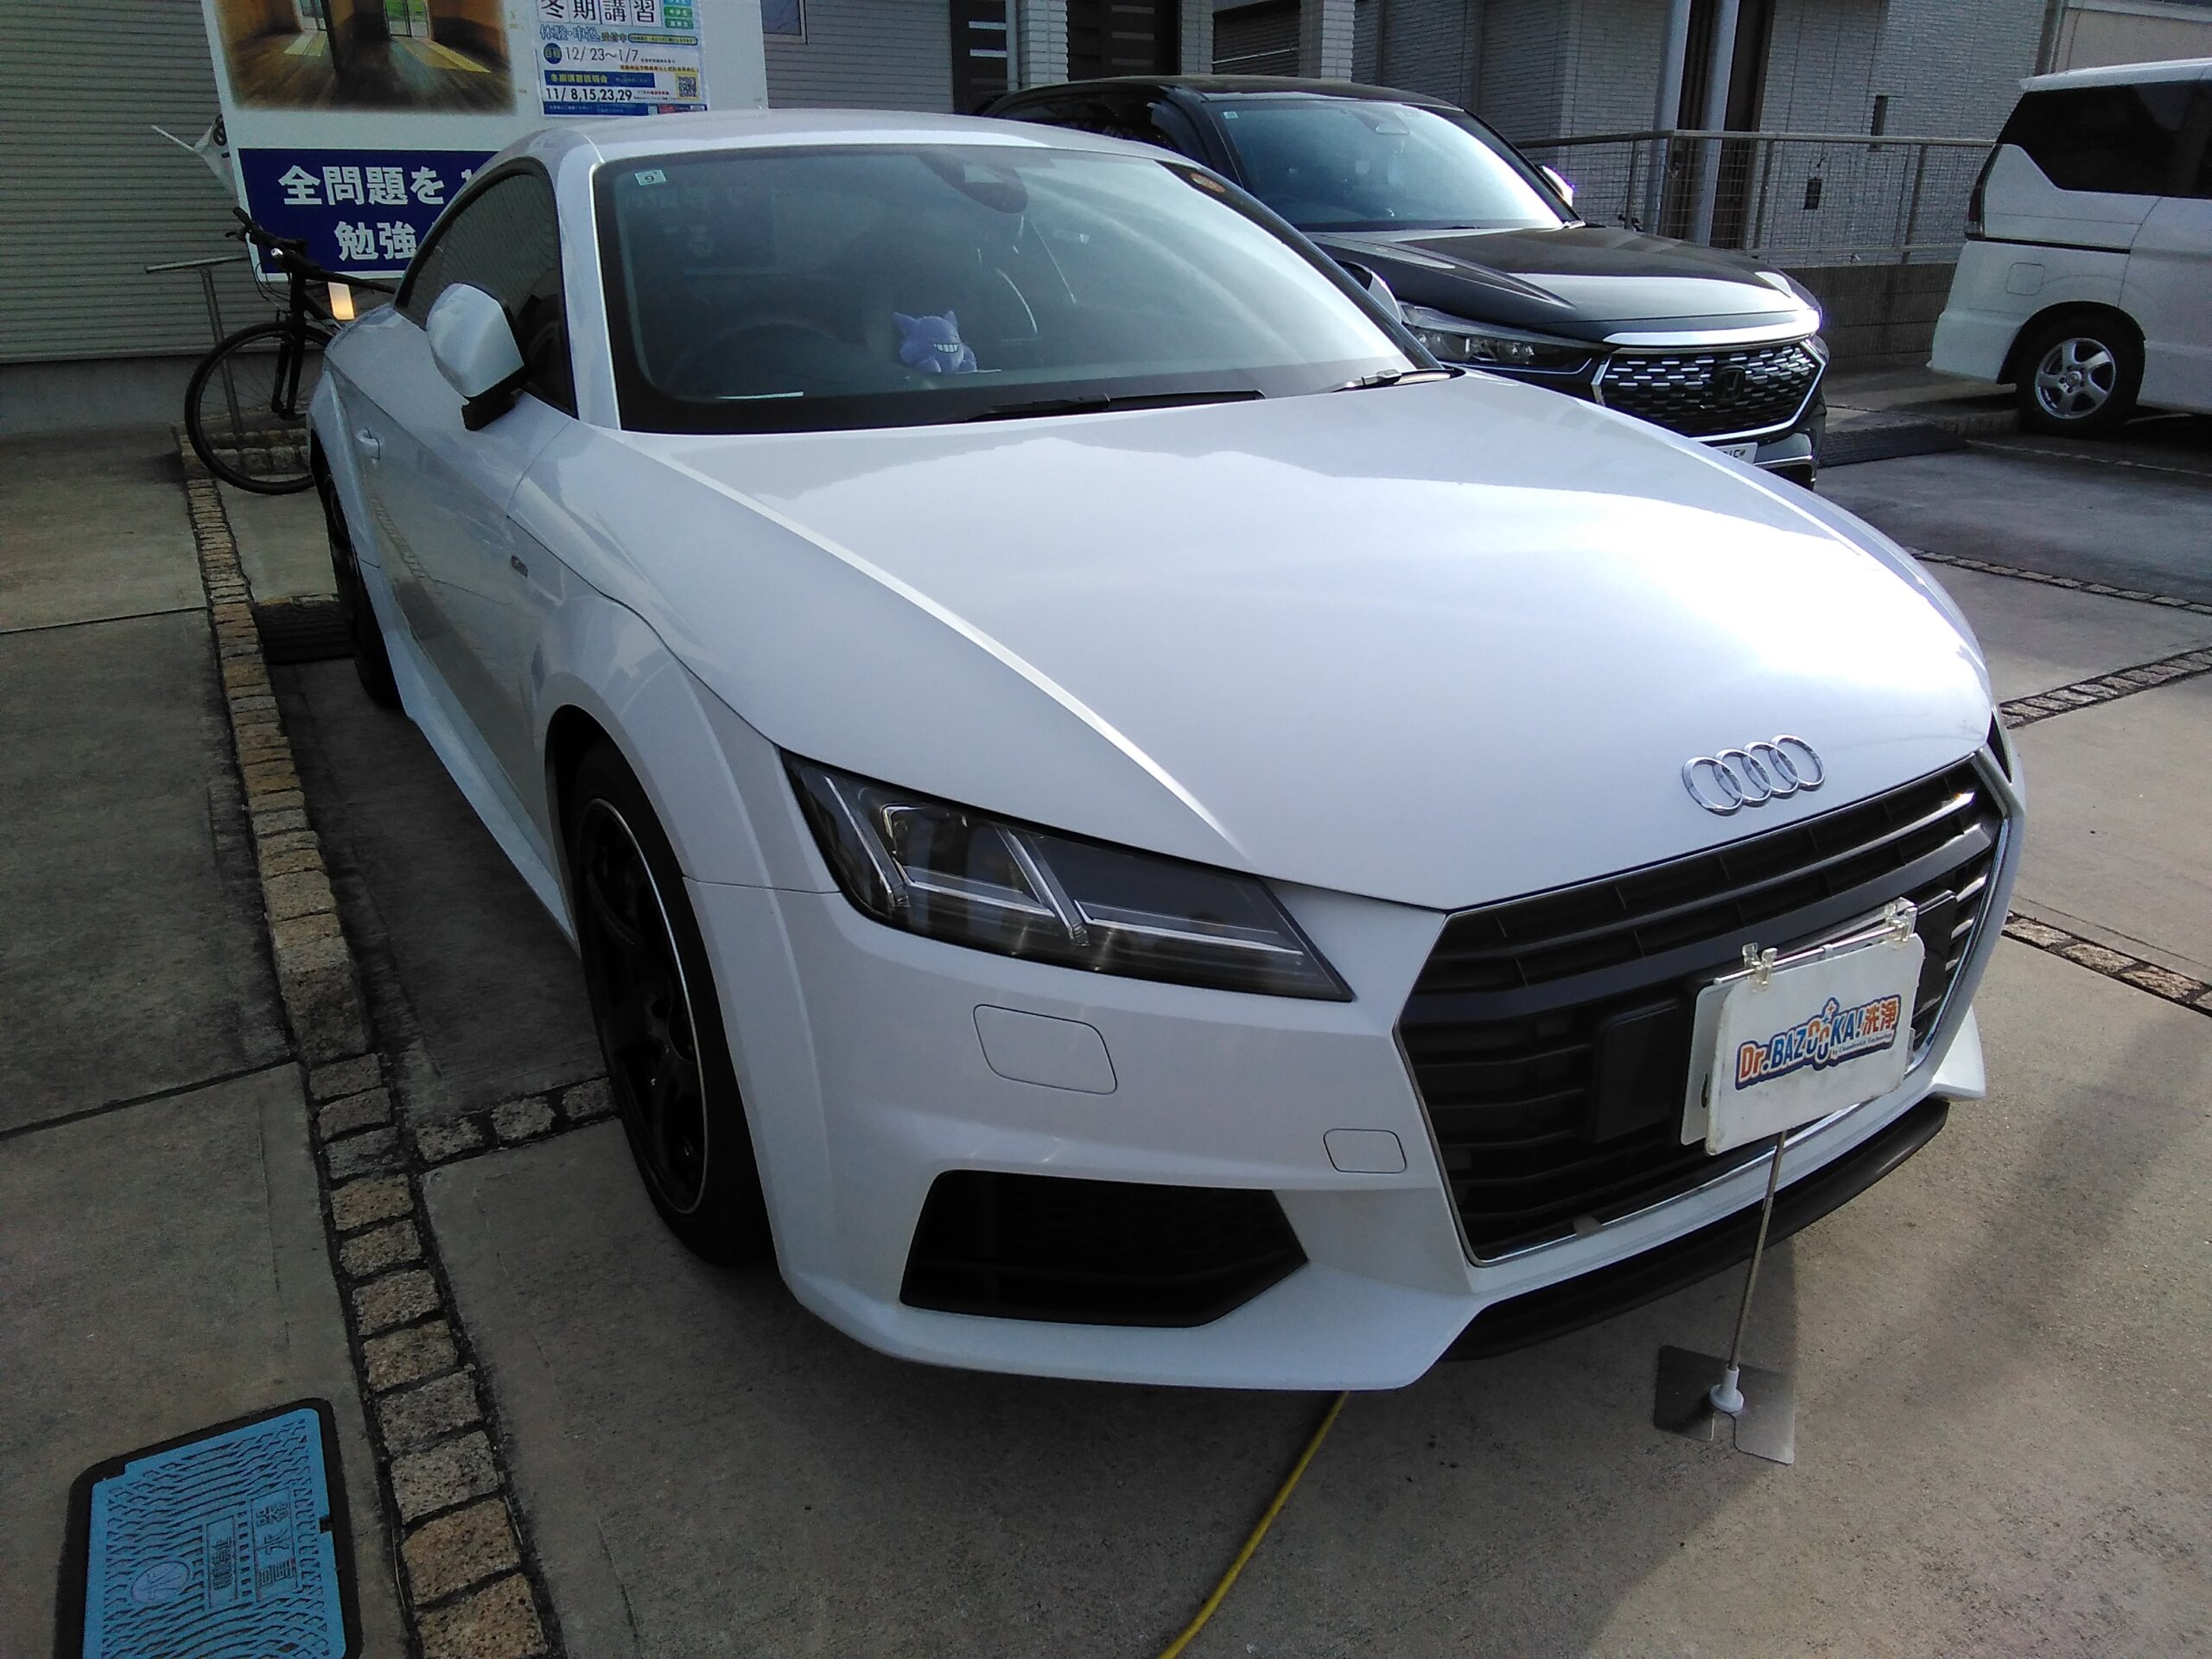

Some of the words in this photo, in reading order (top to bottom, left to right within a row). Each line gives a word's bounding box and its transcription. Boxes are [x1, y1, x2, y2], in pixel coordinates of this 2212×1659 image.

[277, 164, 445, 207] 全問題を
[334, 220, 418, 262] 勉強
